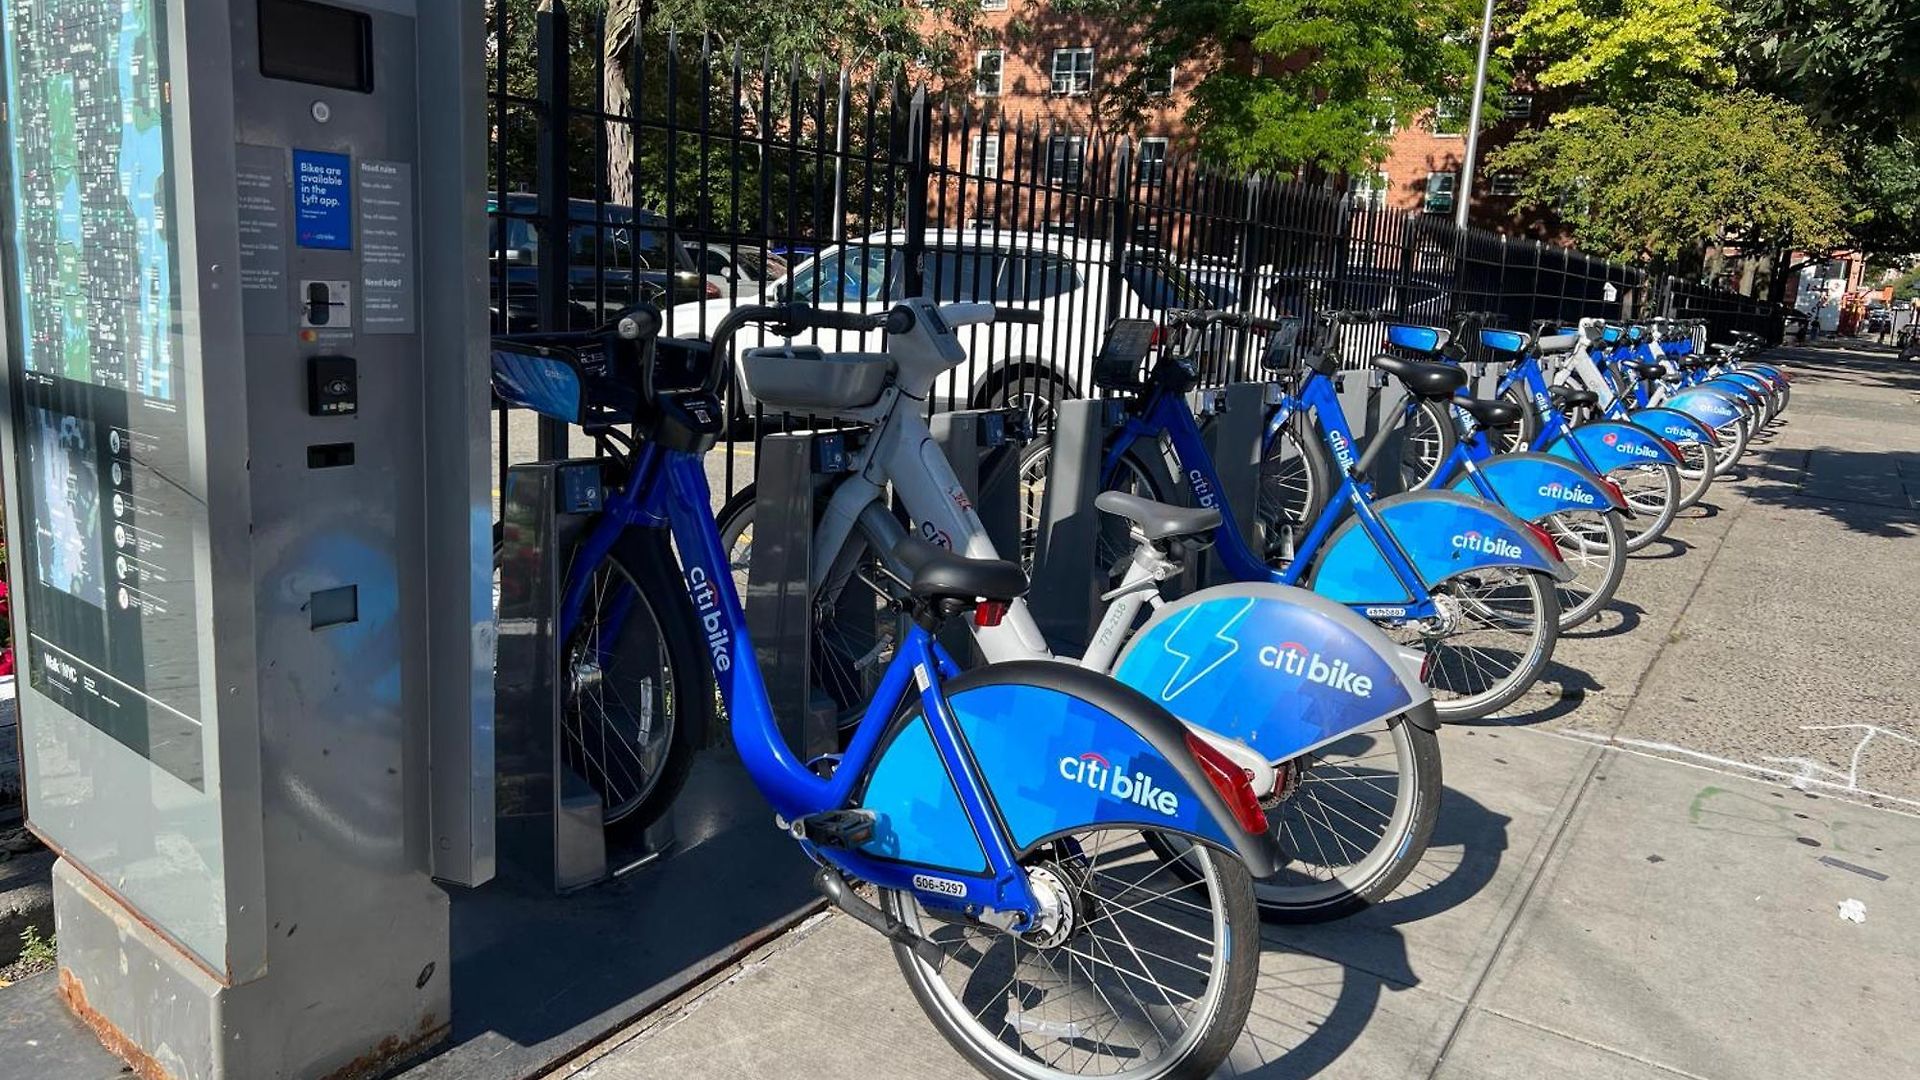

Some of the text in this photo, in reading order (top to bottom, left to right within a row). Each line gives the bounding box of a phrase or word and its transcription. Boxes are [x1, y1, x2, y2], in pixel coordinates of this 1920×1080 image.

[301, 162, 341, 175] Bikes are
[301, 174, 342, 186] available
[301, 184, 327, 195] in the
[302, 194, 340, 208] Lyft app.
[1616, 442, 1658, 458] citi bike
[1538, 483, 1594, 504] citi bike
[922, 521, 950, 549] cit
[1452, 531, 1522, 559] citi bike
[690, 567, 730, 672] citi bike
[1259, 642, 1373, 698] citi bike
[1060, 753, 1179, 816] citi bike
[916, 877, 963, 894] 506-5297
